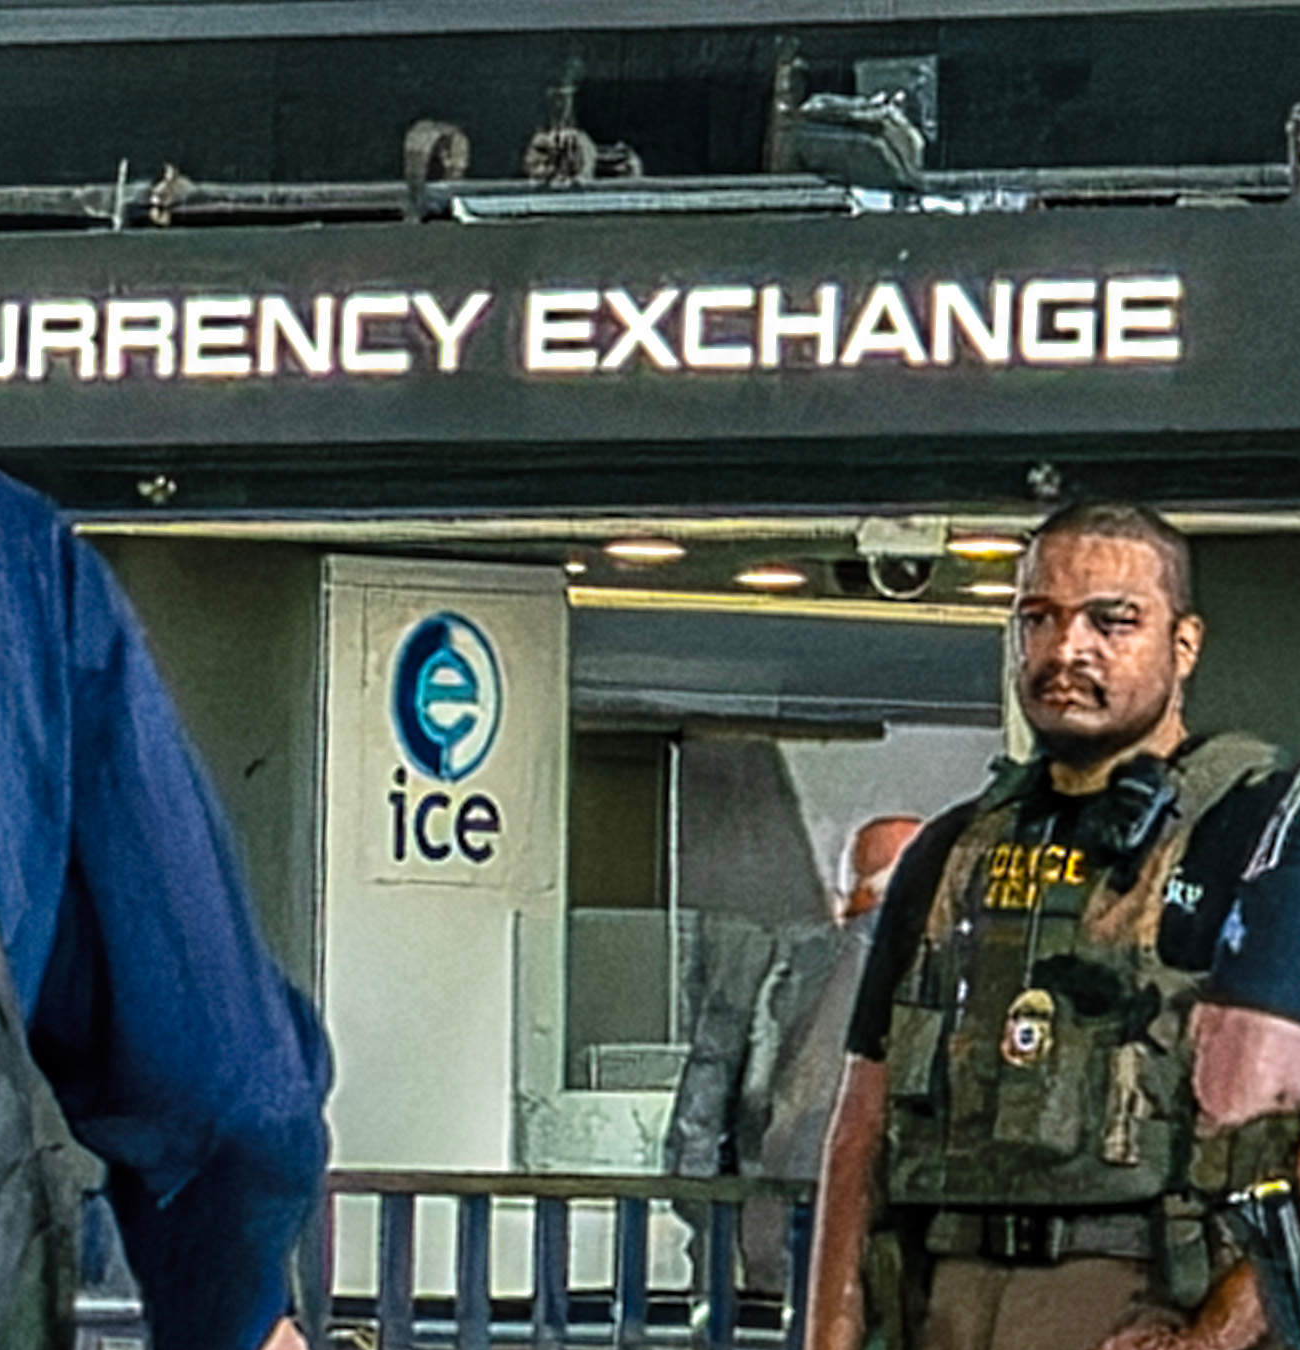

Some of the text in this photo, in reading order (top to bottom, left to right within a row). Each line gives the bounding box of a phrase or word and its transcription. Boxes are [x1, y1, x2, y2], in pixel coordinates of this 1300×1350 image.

[523, 274, 1184, 373] EXCHANGE
[388, 764, 501, 863] ice
[987, 843, 1086, 887] OLICE
